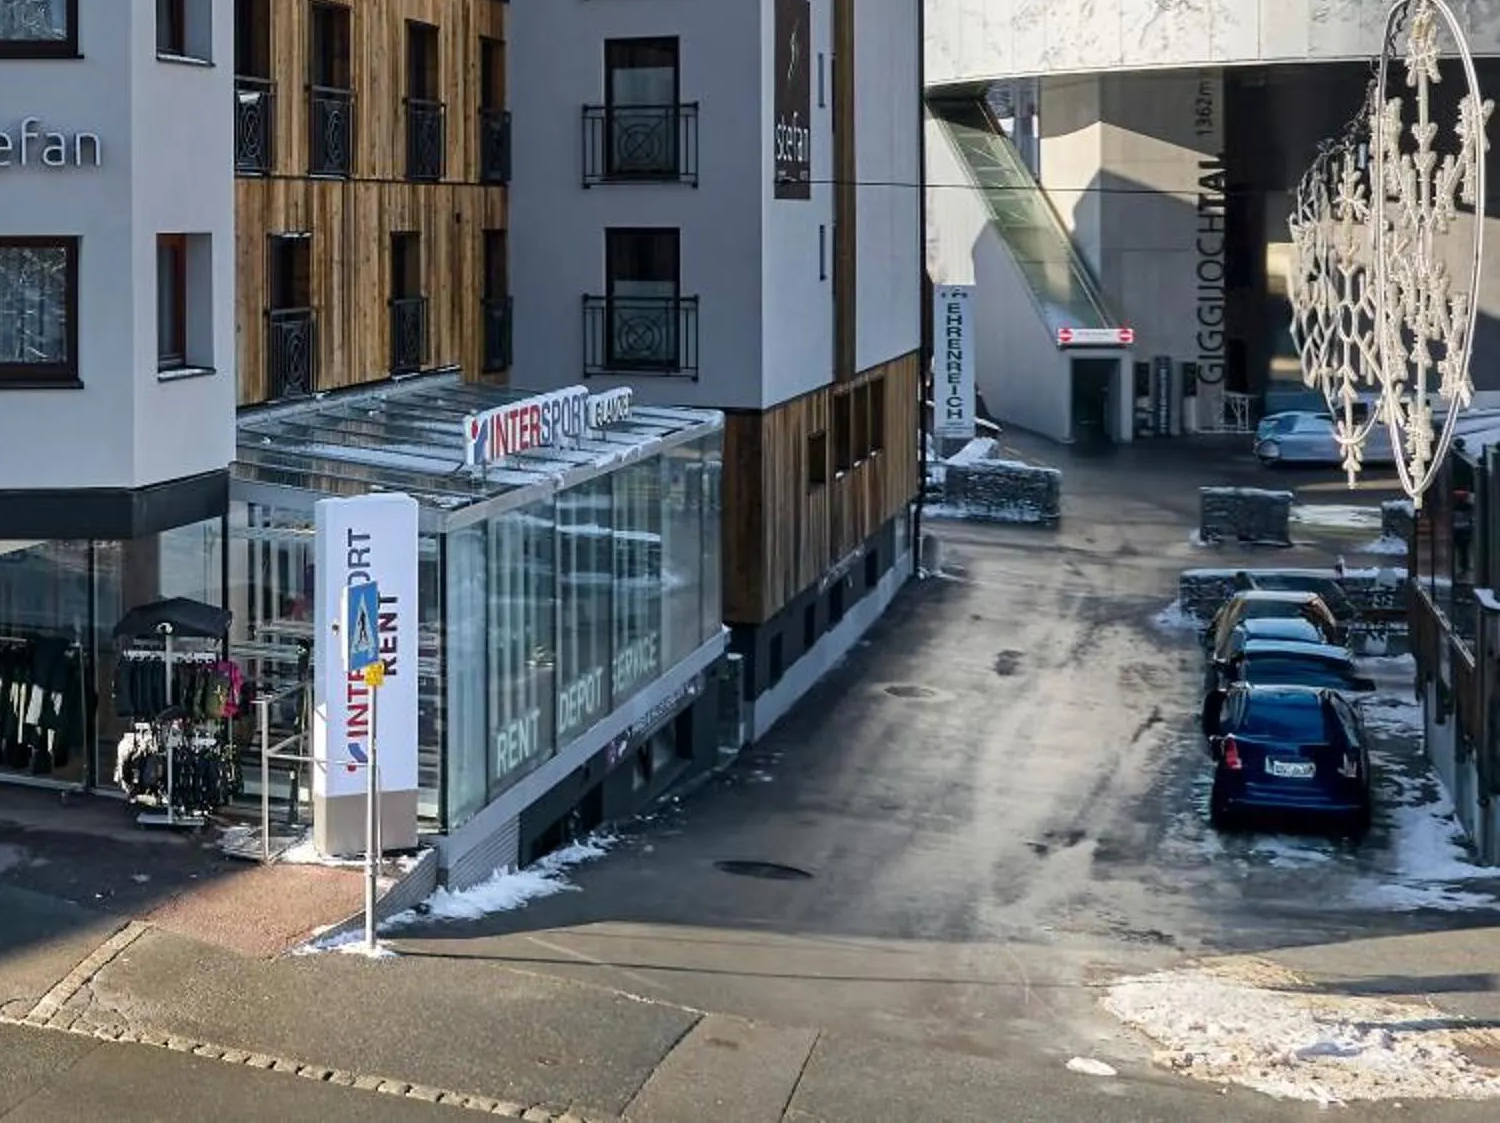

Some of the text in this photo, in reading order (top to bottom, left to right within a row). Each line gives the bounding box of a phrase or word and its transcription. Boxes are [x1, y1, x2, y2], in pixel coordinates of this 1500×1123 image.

[1196, 81, 1214, 136] 1362m
[946, 302, 962, 419] EHRENREICH
[490, 392, 588, 461] INTERSPORT
[347, 528, 371, 737] INTEORT
[559, 666, 603, 734] DEPOT
[496, 707, 541, 777] RENT
